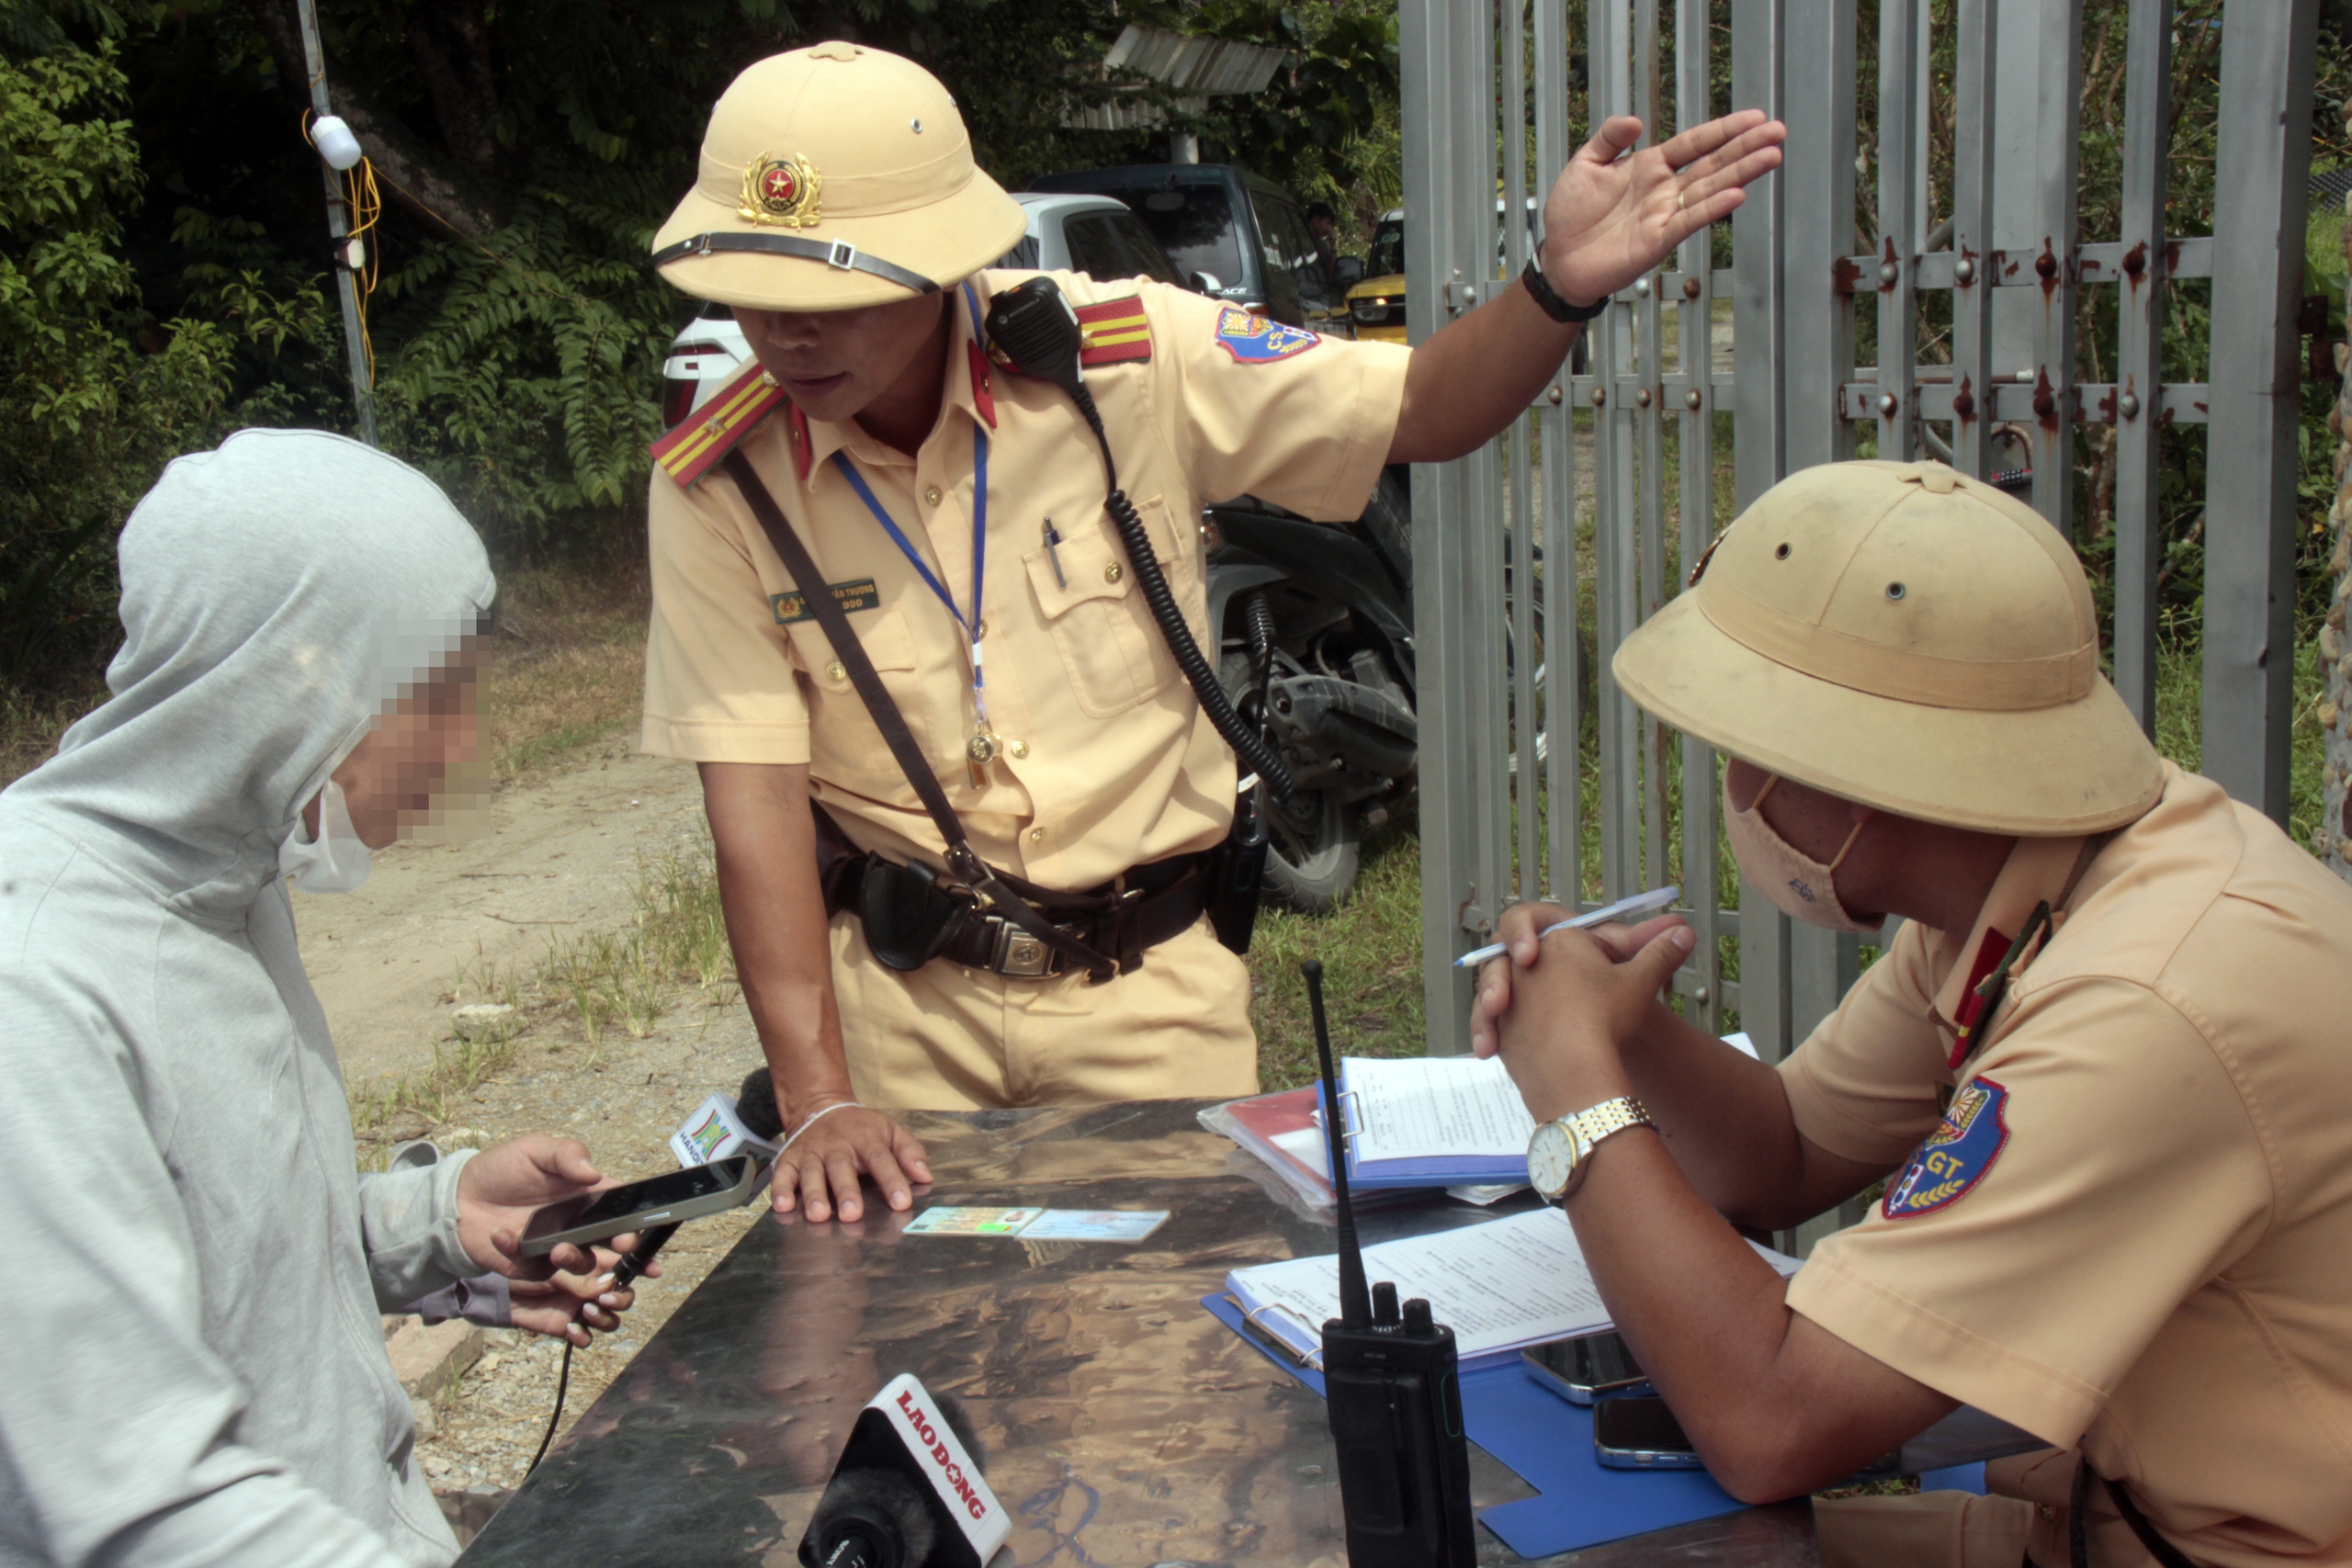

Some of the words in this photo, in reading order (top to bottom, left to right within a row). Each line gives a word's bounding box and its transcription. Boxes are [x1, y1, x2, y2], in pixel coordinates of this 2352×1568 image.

[1267, 332, 1284, 350] CS
[842, 598, 863, 610] 990
[679, 1132, 705, 1165] HANOI
[1927, 1150, 1964, 1180] GT
[896, 1390, 936, 1447] LAO
